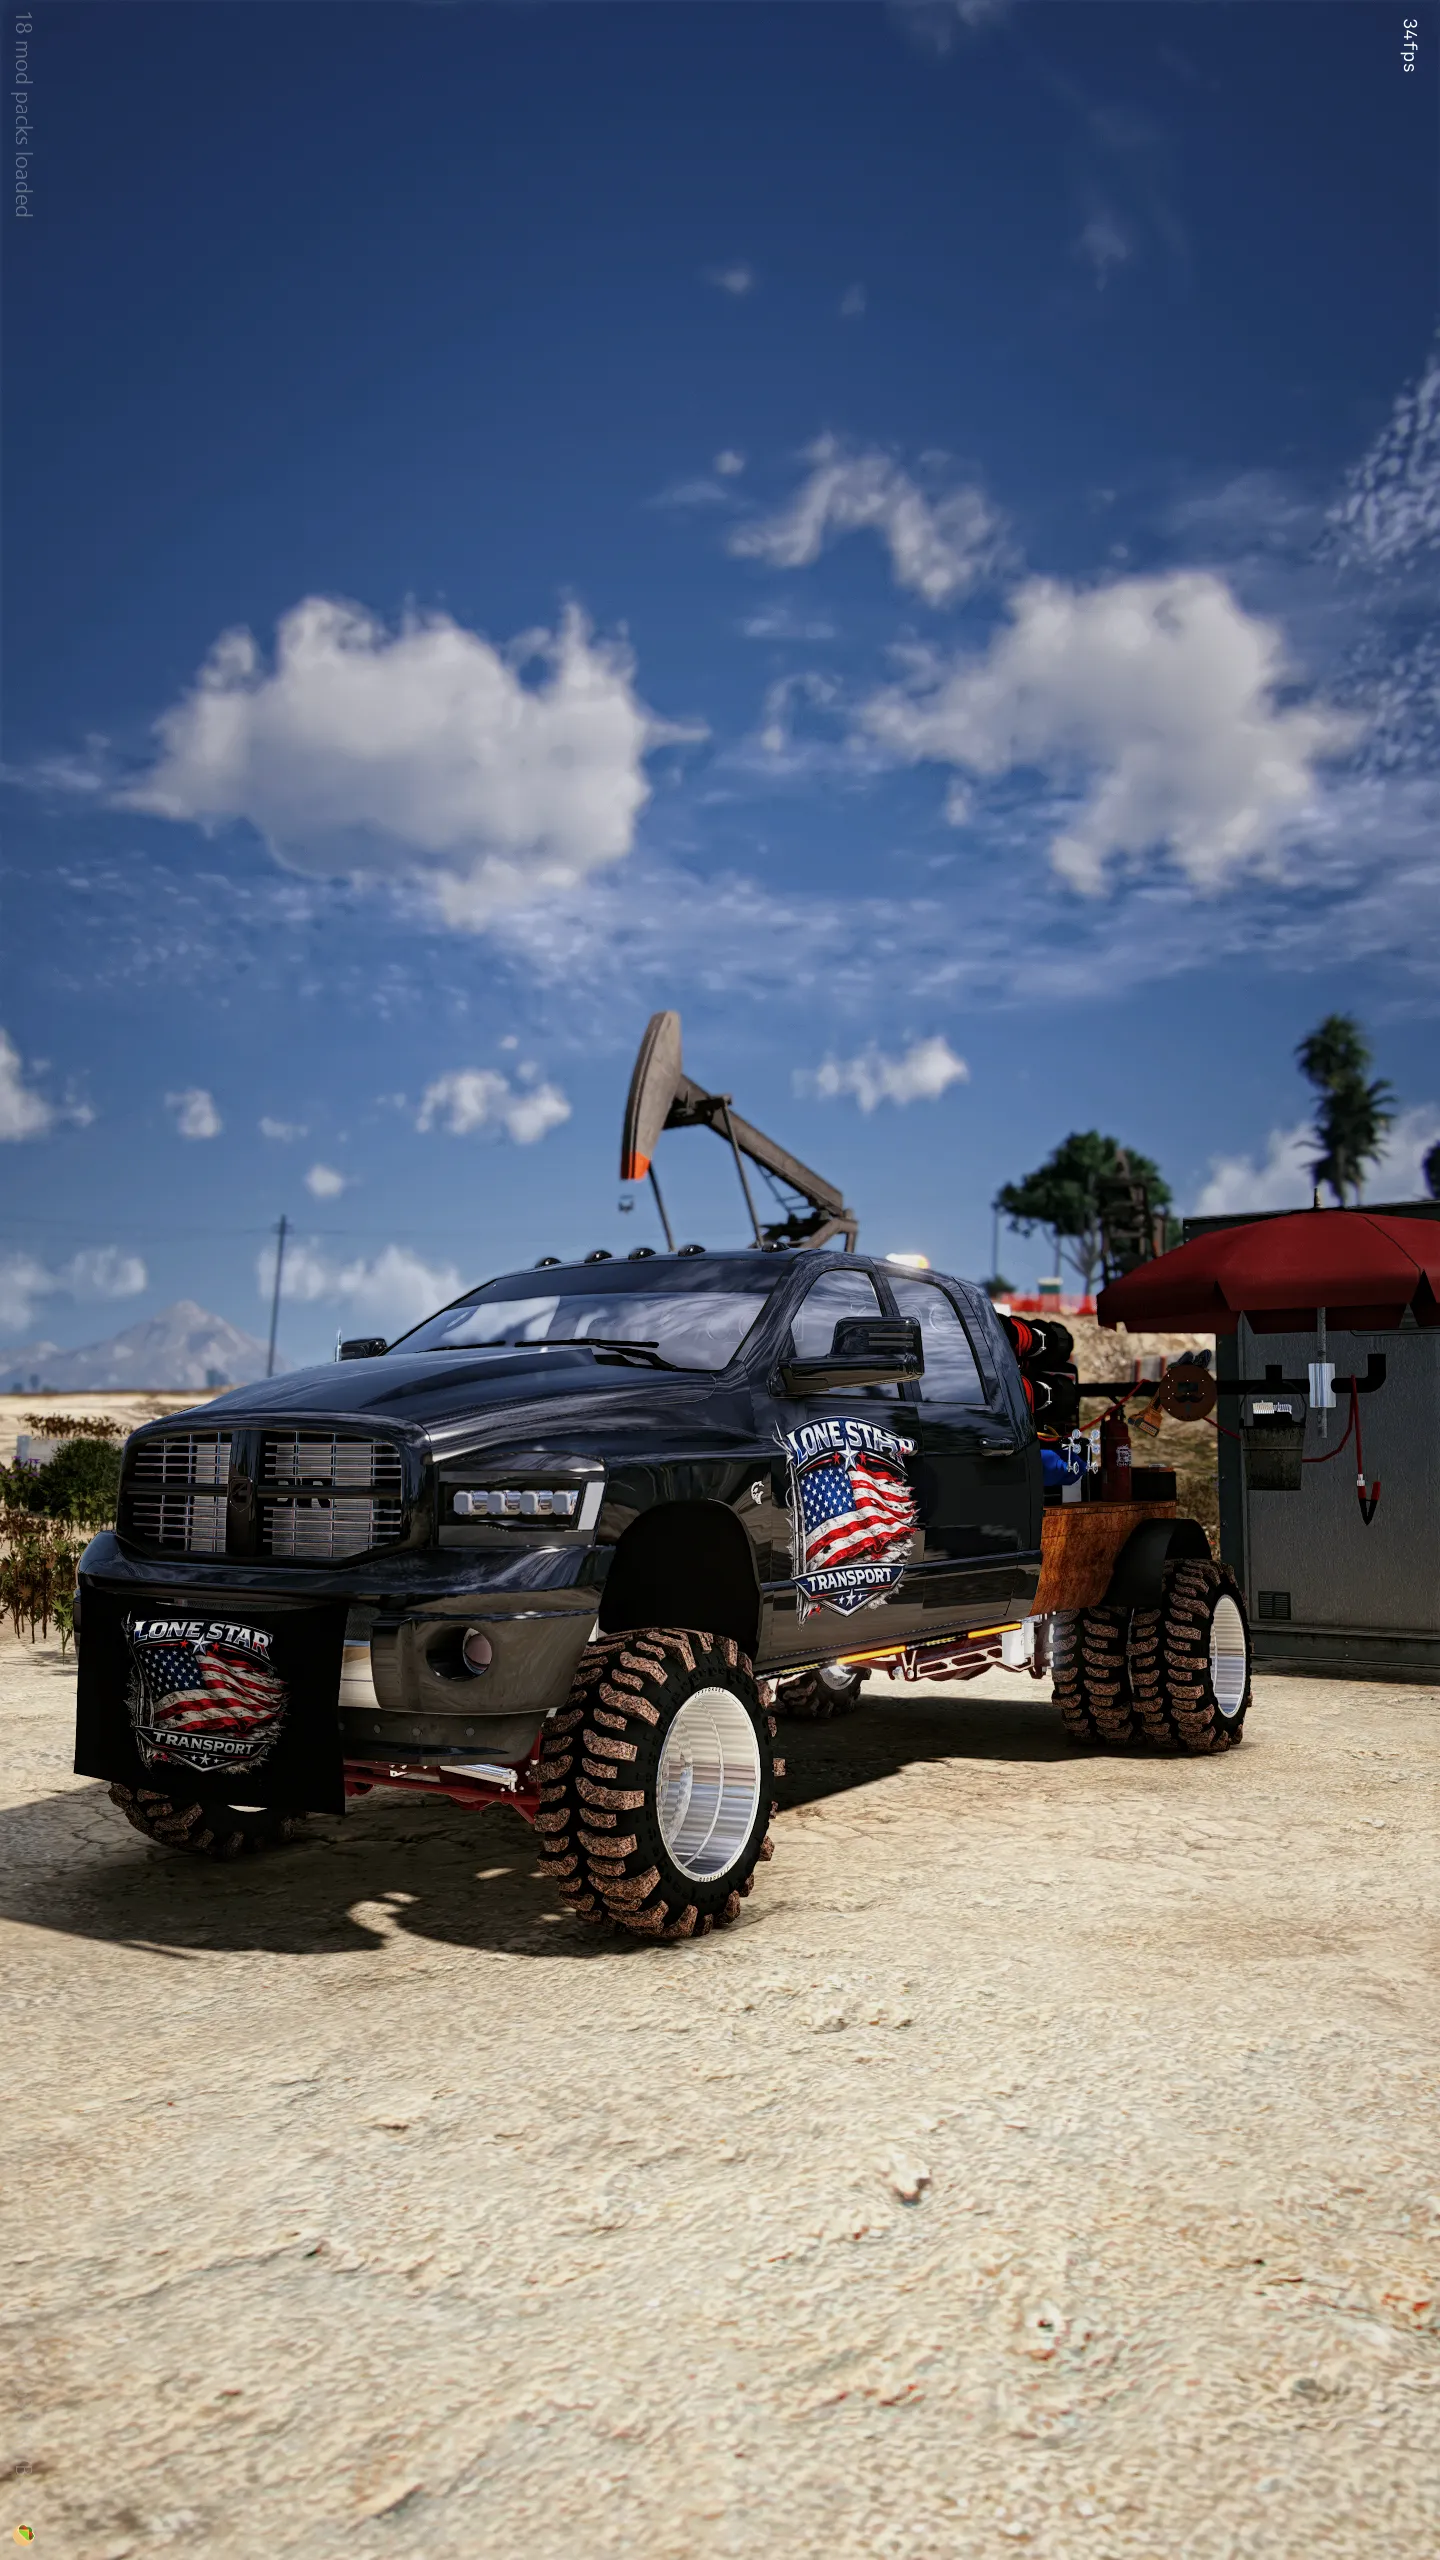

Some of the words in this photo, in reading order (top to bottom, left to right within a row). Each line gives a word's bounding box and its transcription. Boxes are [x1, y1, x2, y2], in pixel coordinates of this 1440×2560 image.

[786, 1420, 844, 1469] LONE
[845, 1420, 915, 1469] STAR
[806, 1567, 892, 1592] TRANSPORT
[133, 1621, 204, 1645] LONE
[206, 1622, 272, 1660] STAR
[153, 1731, 254, 1755] TRANSPORT
